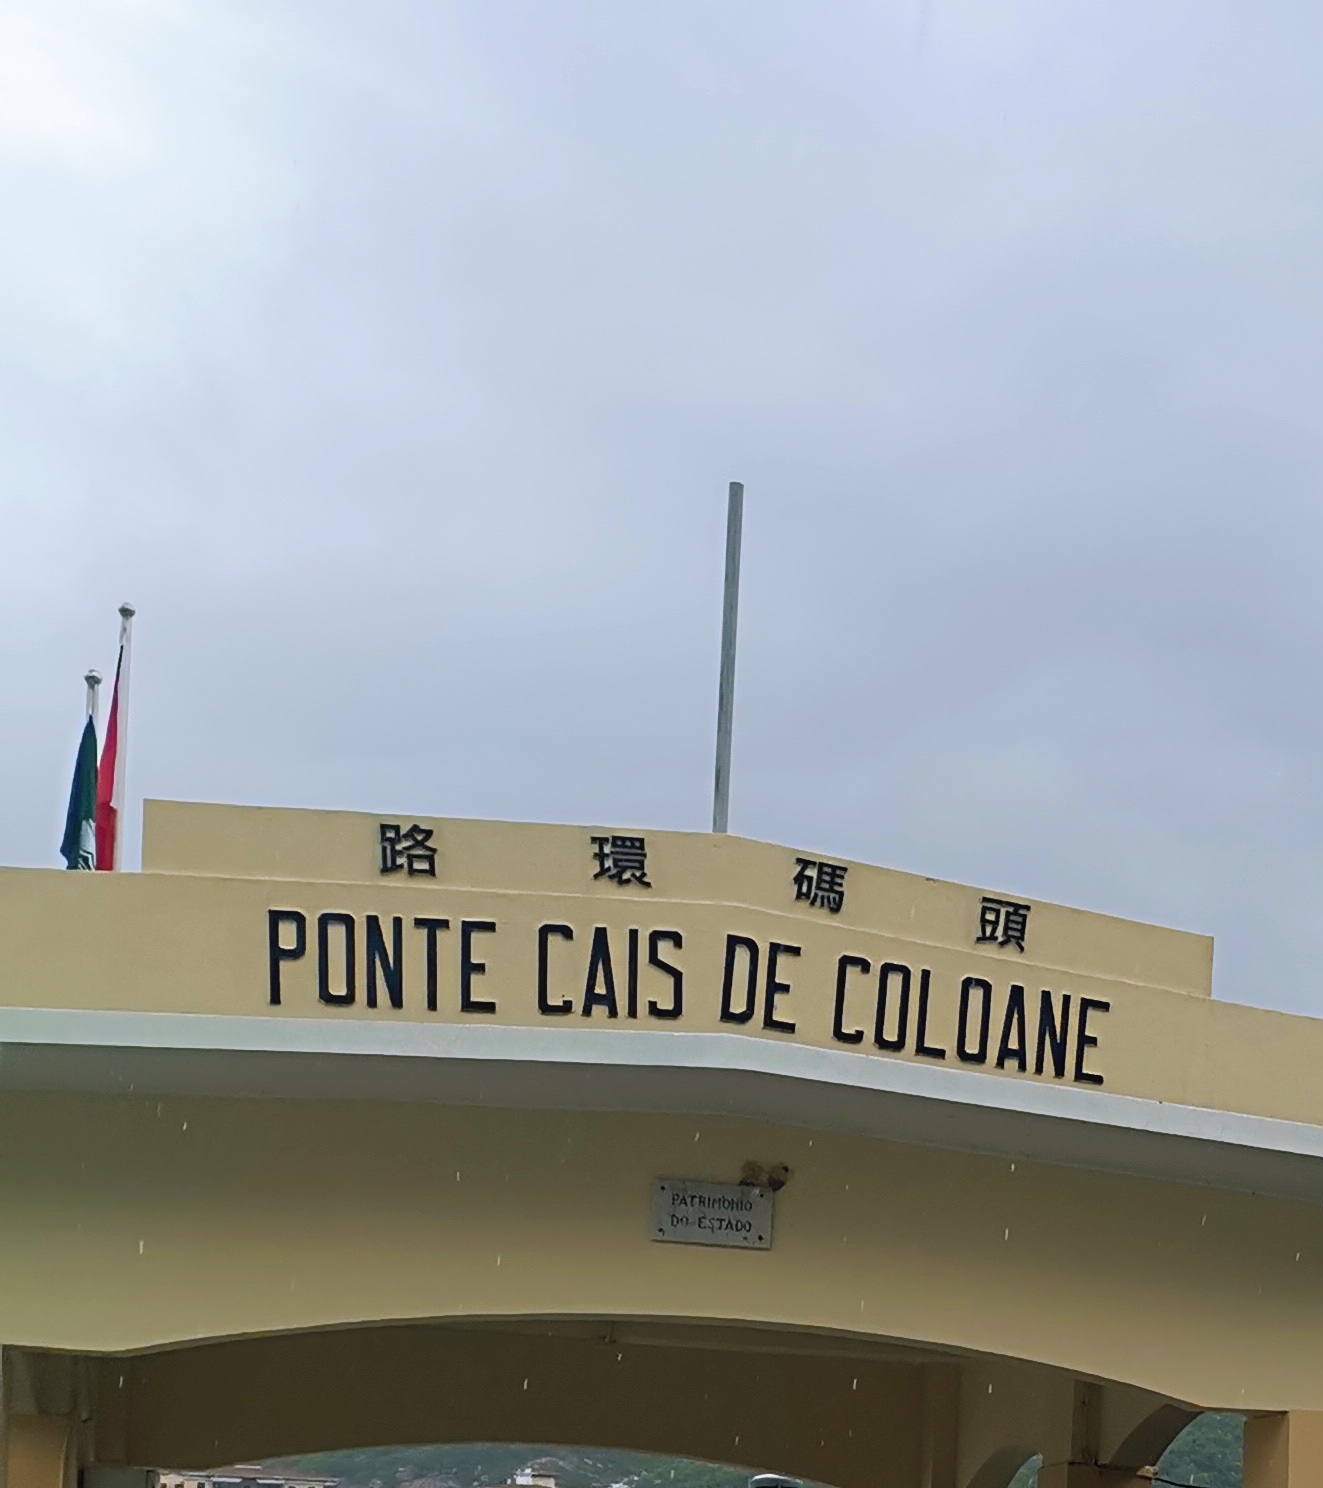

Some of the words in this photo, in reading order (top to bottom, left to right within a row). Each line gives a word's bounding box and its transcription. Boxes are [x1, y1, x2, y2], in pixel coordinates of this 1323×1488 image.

[379, 823, 1031, 954] 路環碼頭
[268, 908, 498, 1015] PONTE
[537, 923, 685, 1020] CAIS
[720, 934, 802, 1033] DE
[831, 954, 1112, 1085] COLOANE
[670, 1213, 690, 1228] DO
[697, 1215, 753, 1233] ESTADO
